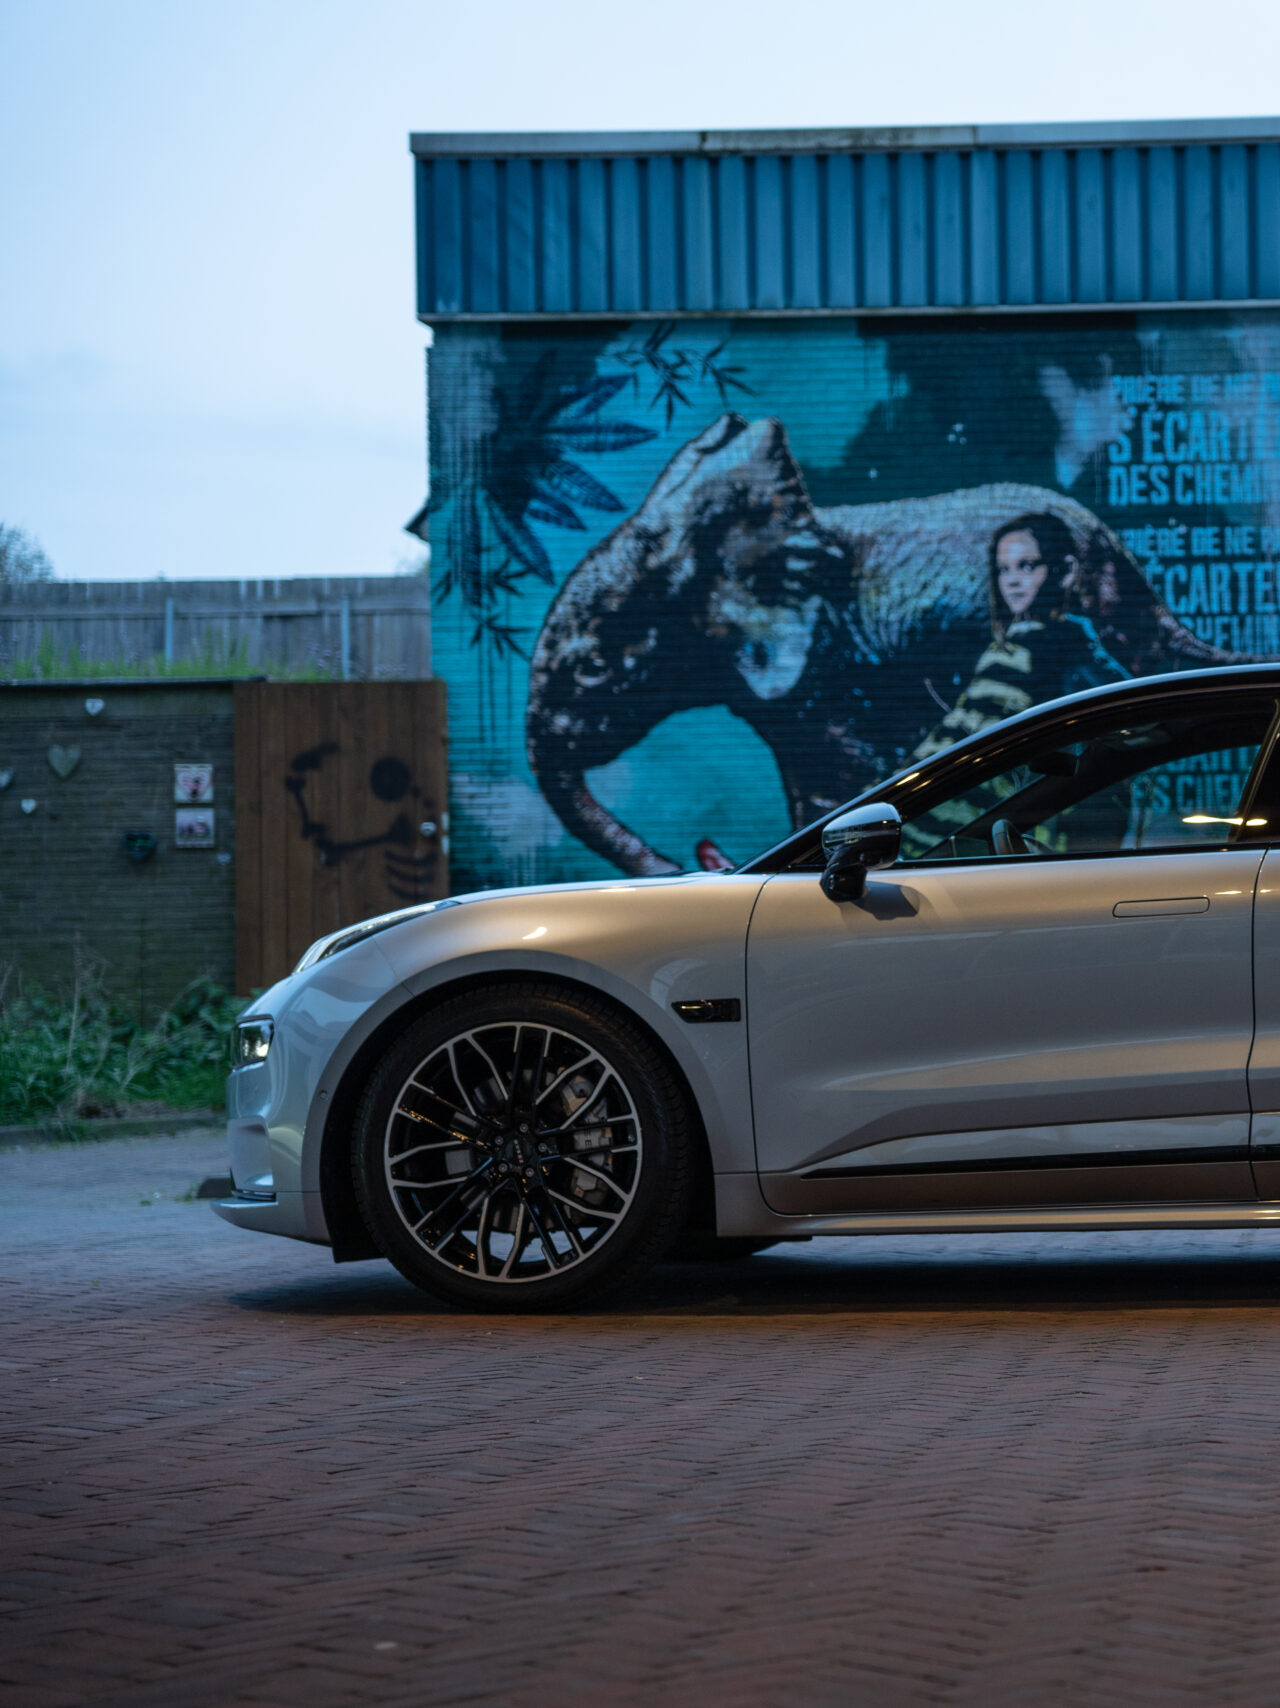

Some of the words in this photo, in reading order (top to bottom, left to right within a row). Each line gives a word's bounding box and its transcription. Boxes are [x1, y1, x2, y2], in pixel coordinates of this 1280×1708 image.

[1109, 464, 1170, 506] DES
[1191, 527, 1222, 556] DE
[1225, 526, 1254, 555] NE
